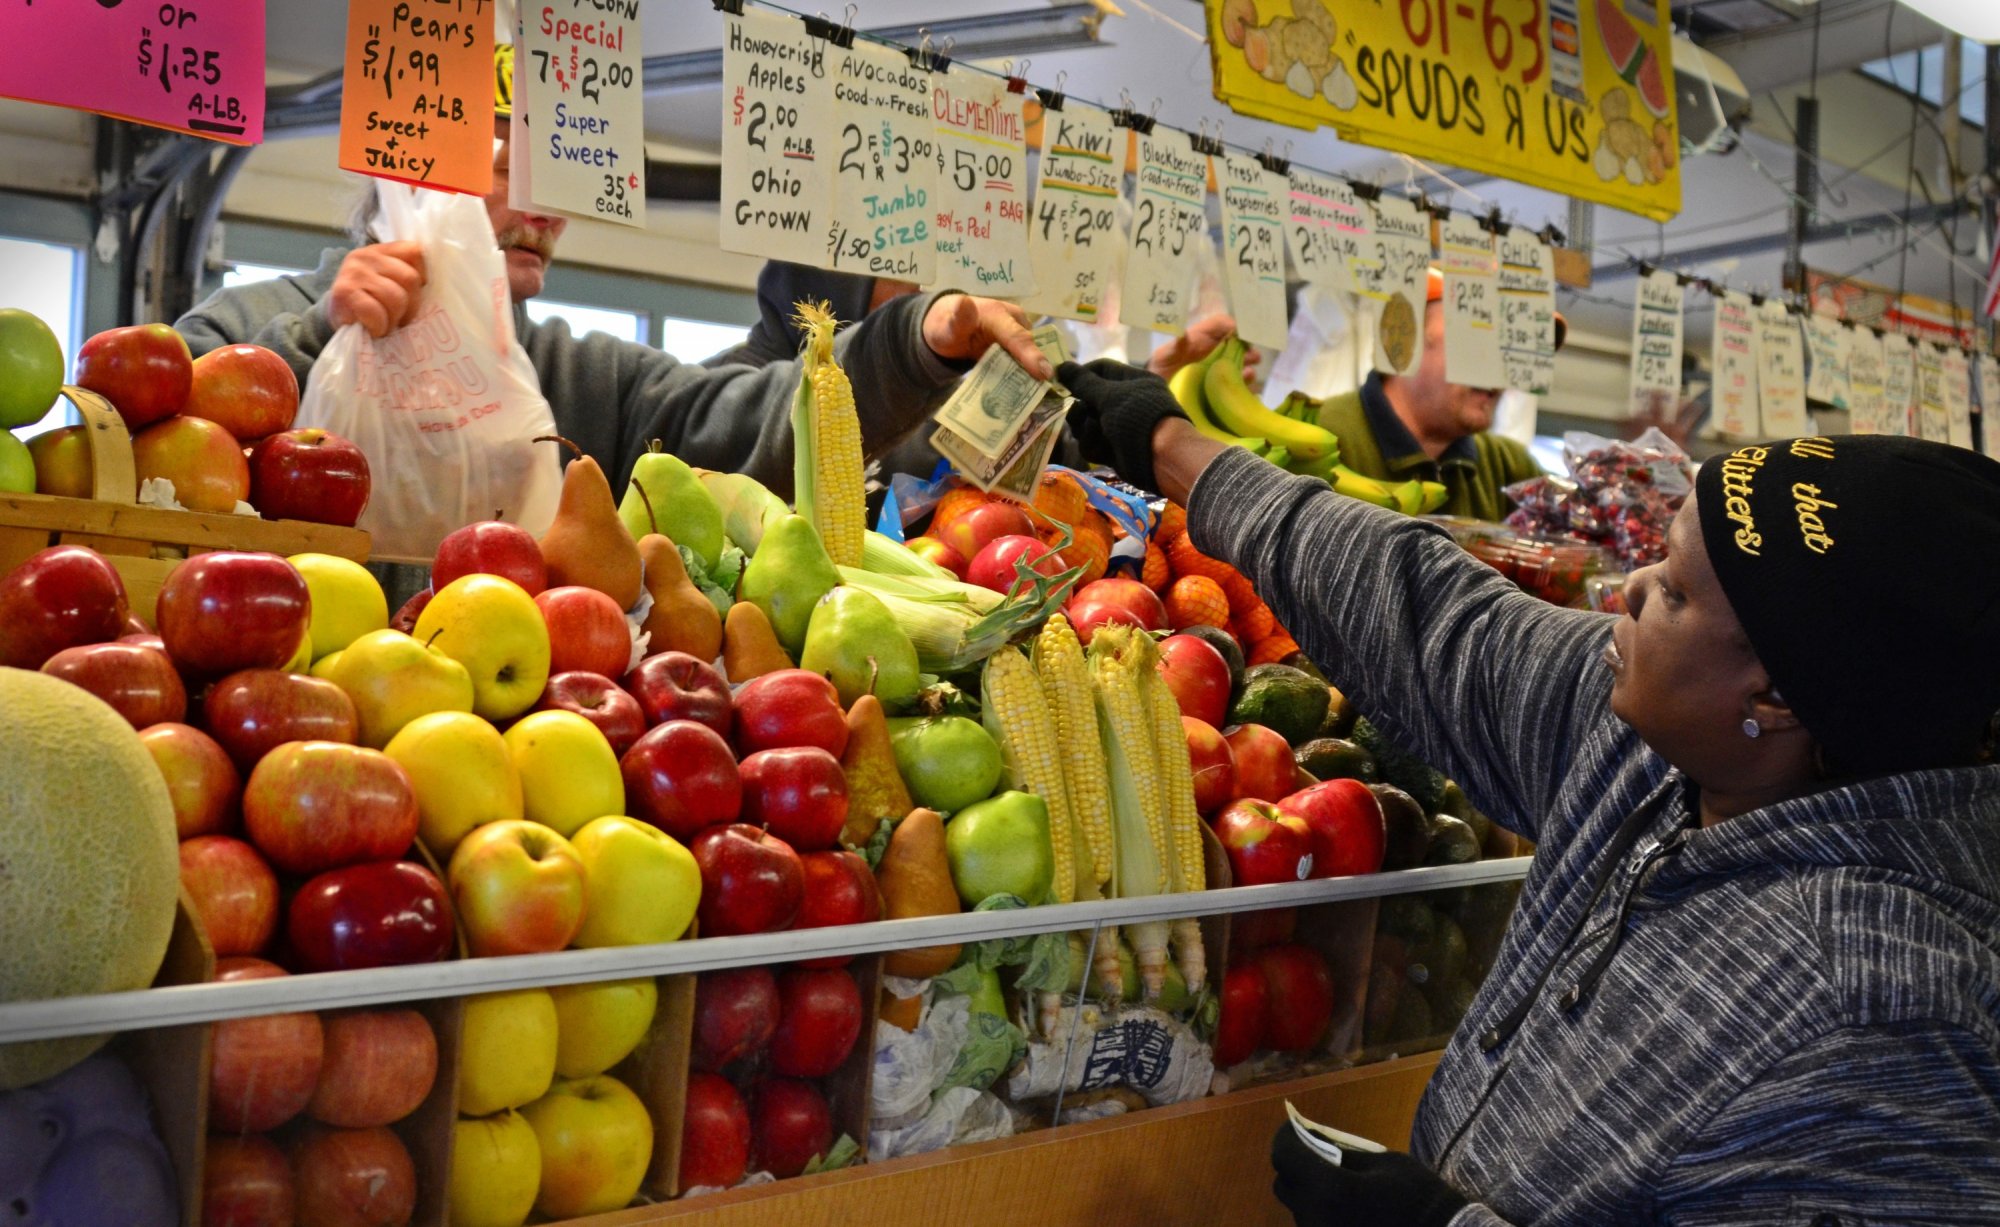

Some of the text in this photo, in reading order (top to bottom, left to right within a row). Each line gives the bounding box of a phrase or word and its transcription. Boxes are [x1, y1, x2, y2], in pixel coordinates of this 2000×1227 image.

[541, 7, 623, 52] Special
[532, 50, 549, 83] 7
[748, 62, 806, 94] Apples
[366, 111, 430, 139] Sweet
[555, 103, 609, 135] Super
[550, 134, 619, 167] Sweet
[839, 123, 865, 180] 2
[1056, 119, 1113, 156] Kiwi
[365, 147, 435, 181] Juicy
[1143, 141, 1206, 179] Blackberries
[596, 197, 632, 218] each
[863, 185, 927, 219] Jumbo
[1000, 200, 1024, 224] BAG
[967, 216, 991, 239] Peel
[1038, 200, 1056, 241] 4
[1136, 199, 1153, 257] 2
[869, 252, 919, 274] each
[976, 259, 1014, 285] Good!
[1792, 481, 1839, 554] that
